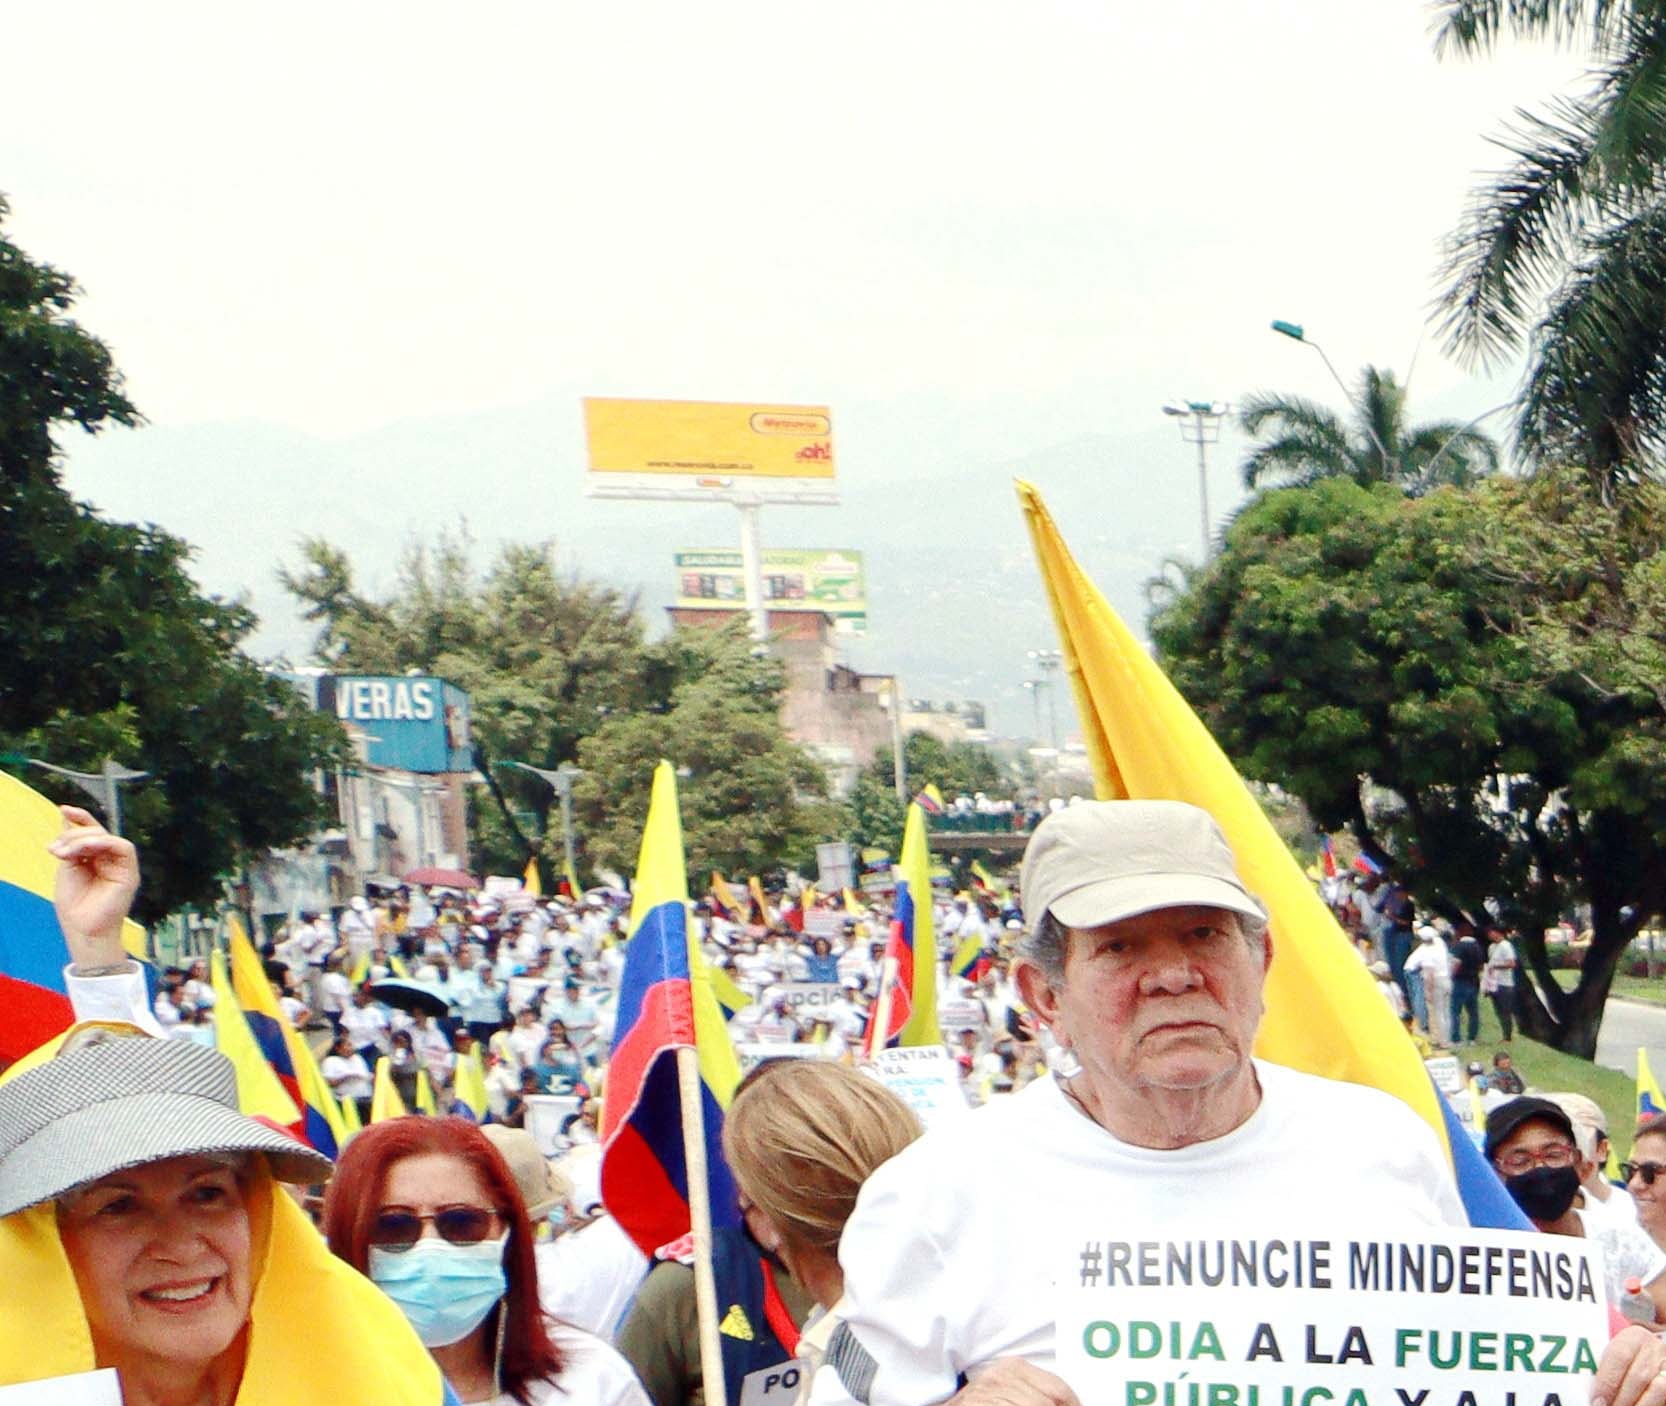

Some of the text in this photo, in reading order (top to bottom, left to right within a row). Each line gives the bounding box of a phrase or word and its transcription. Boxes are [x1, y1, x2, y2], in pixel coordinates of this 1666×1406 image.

[1080, 1239, 1598, 1304] #RENUNCIE MINDEFENSA
[1082, 1319, 1600, 1375] ODIA A LA FUERZA
